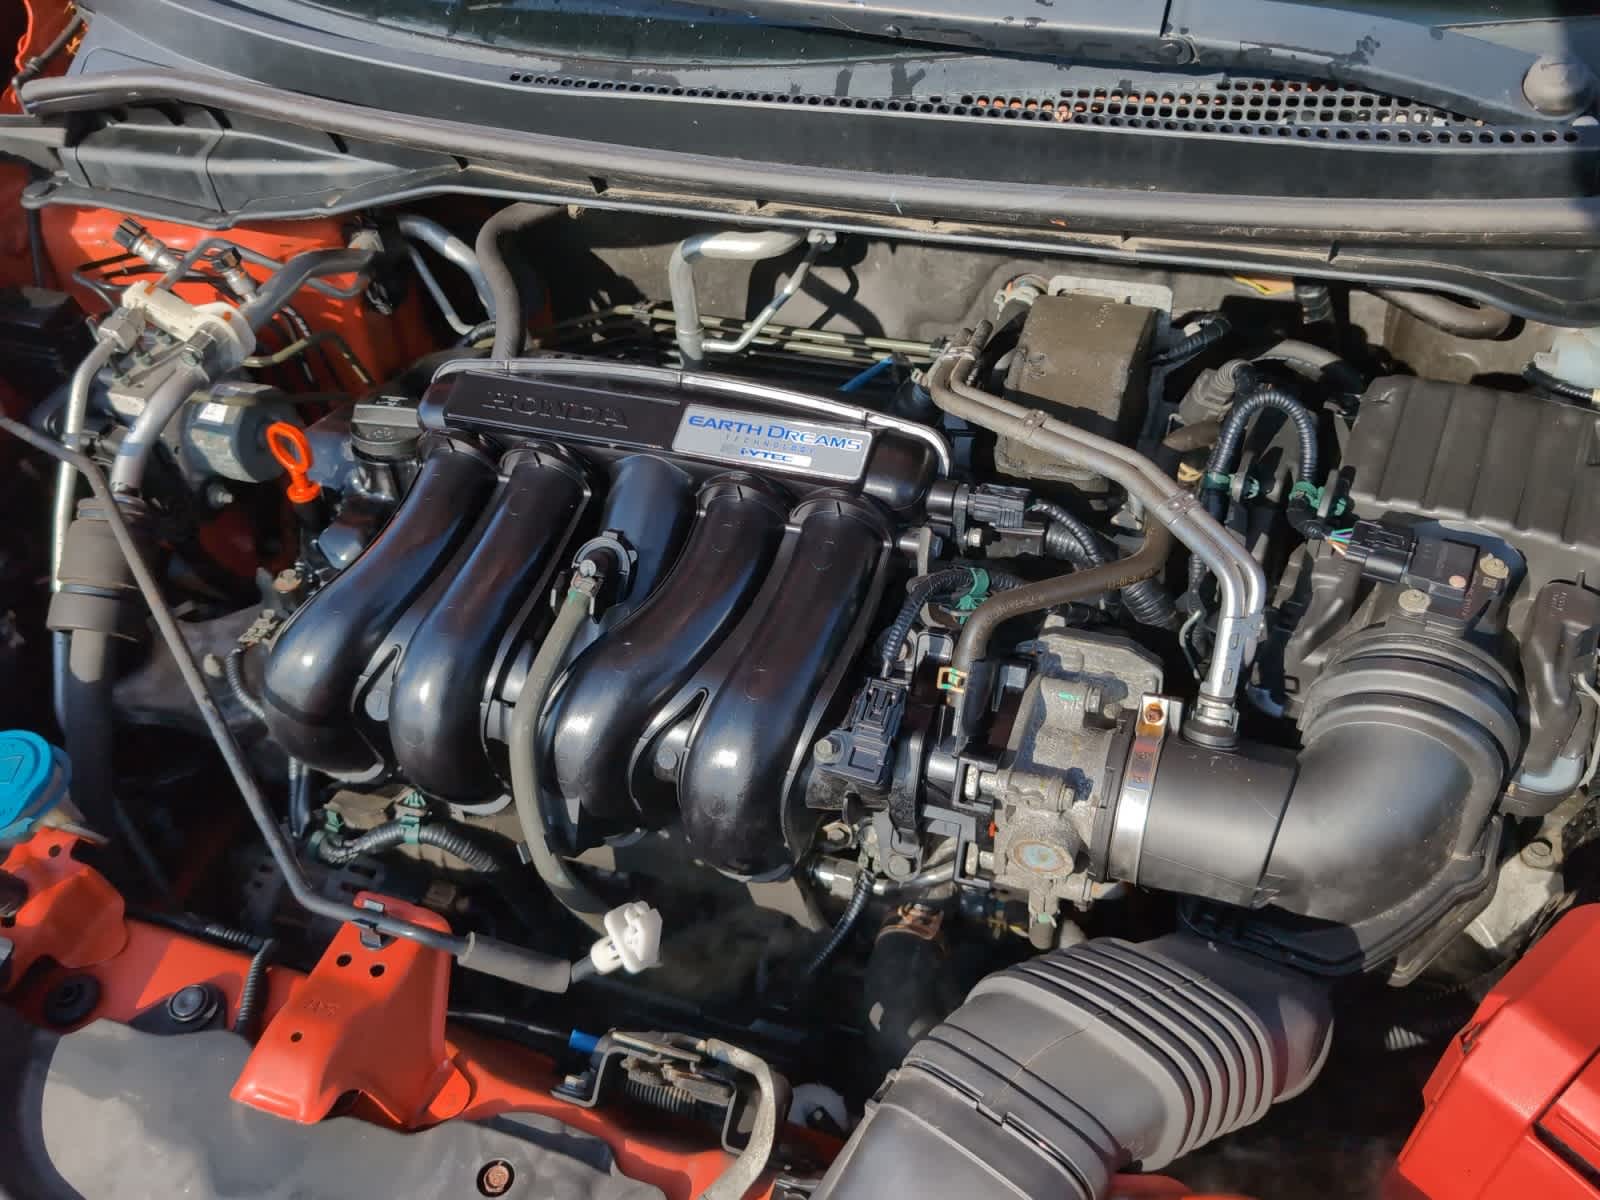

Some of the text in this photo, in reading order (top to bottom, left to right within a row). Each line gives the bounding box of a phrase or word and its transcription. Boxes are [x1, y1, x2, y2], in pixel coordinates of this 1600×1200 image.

[481, 391, 629, 429] HONDA
[688, 415, 862, 451] EARTH DREAMS
